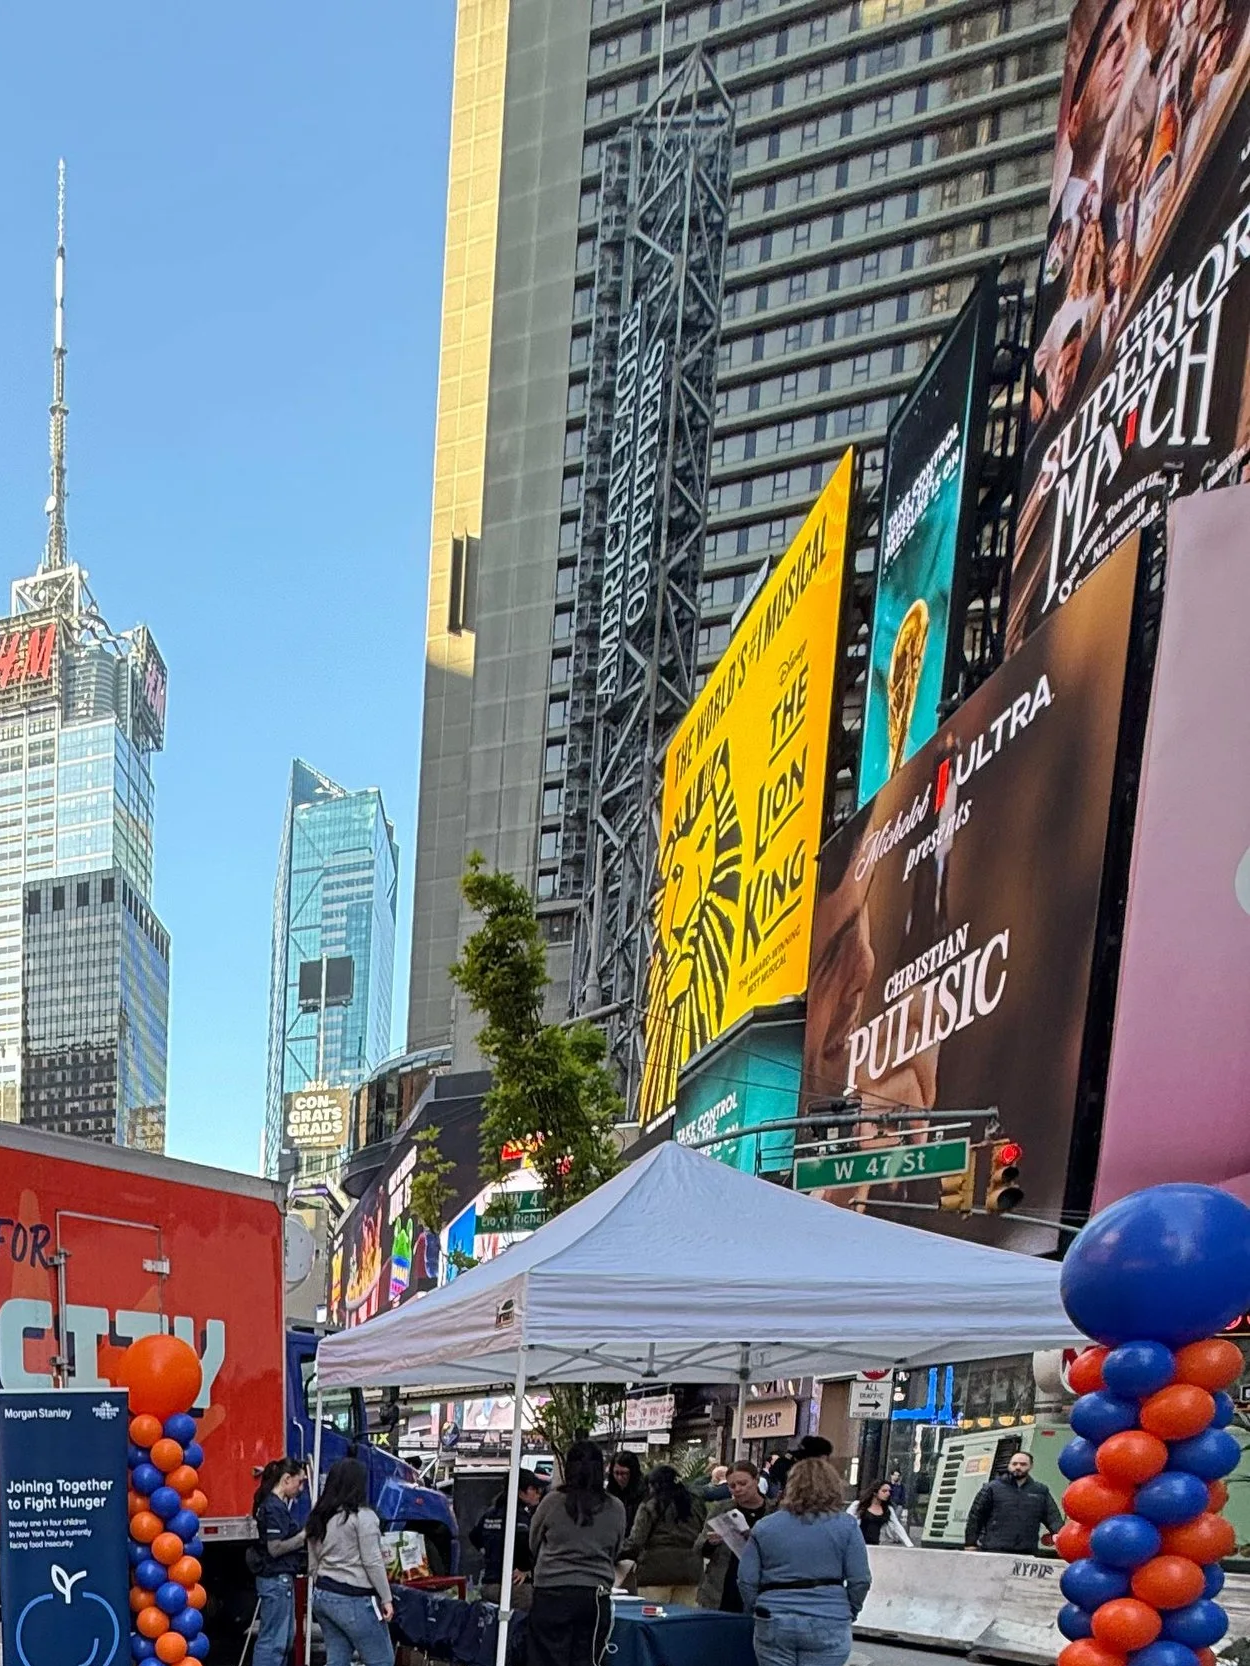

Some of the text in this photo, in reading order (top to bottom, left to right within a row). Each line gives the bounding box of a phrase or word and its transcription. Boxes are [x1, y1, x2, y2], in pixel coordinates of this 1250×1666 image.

[1116, 272, 1174, 357] THE
[942, 446, 960, 481] ON
[1042, 287, 1229, 614] MATCH
[597, 303, 642, 696] AMERICAN EAGLE
[625, 337, 666, 627] OUTFITTERS
[675, 727, 695, 788] THE
[696, 641, 748, 755] WORLD'S
[764, 512, 828, 653] MUSICAL
[778, 639, 808, 687] Disney
[770, 663, 809, 751] THE
[855, 674, 1052, 882] Michelob ULTRA
[753, 743, 809, 866] LION
[902, 799, 973, 883] presents
[740, 839, 805, 967] KING
[884, 922, 970, 1003] CHRISTIAN
[843, 928, 1010, 1097] PULISIC
[289, 1106, 342, 1123] GRATS
[295, 1094, 337, 1109] CON-
[697, 1092, 738, 1131] CONTROL
[287, 1120, 343, 1137] GRADS
[834, 1151, 926, 1180] W 47 St
[865, 1383, 878, 1392] ALL
[4, 1408, 72, 1421] Morgan Stanley
[6, 1478, 114, 1494] Joining Together
[7, 1495, 106, 1512] to Fight Hunger
[9, 1520, 29, 1529] Nearly
[63, 1518, 87, 1526] children
[9, 1541, 28, 1550] facing
[29, 1540, 43, 1548] food
[16, 1530, 30, 1538] New
[46, 1529, 58, 1538] City
[65, 1528, 92, 1537] currently
